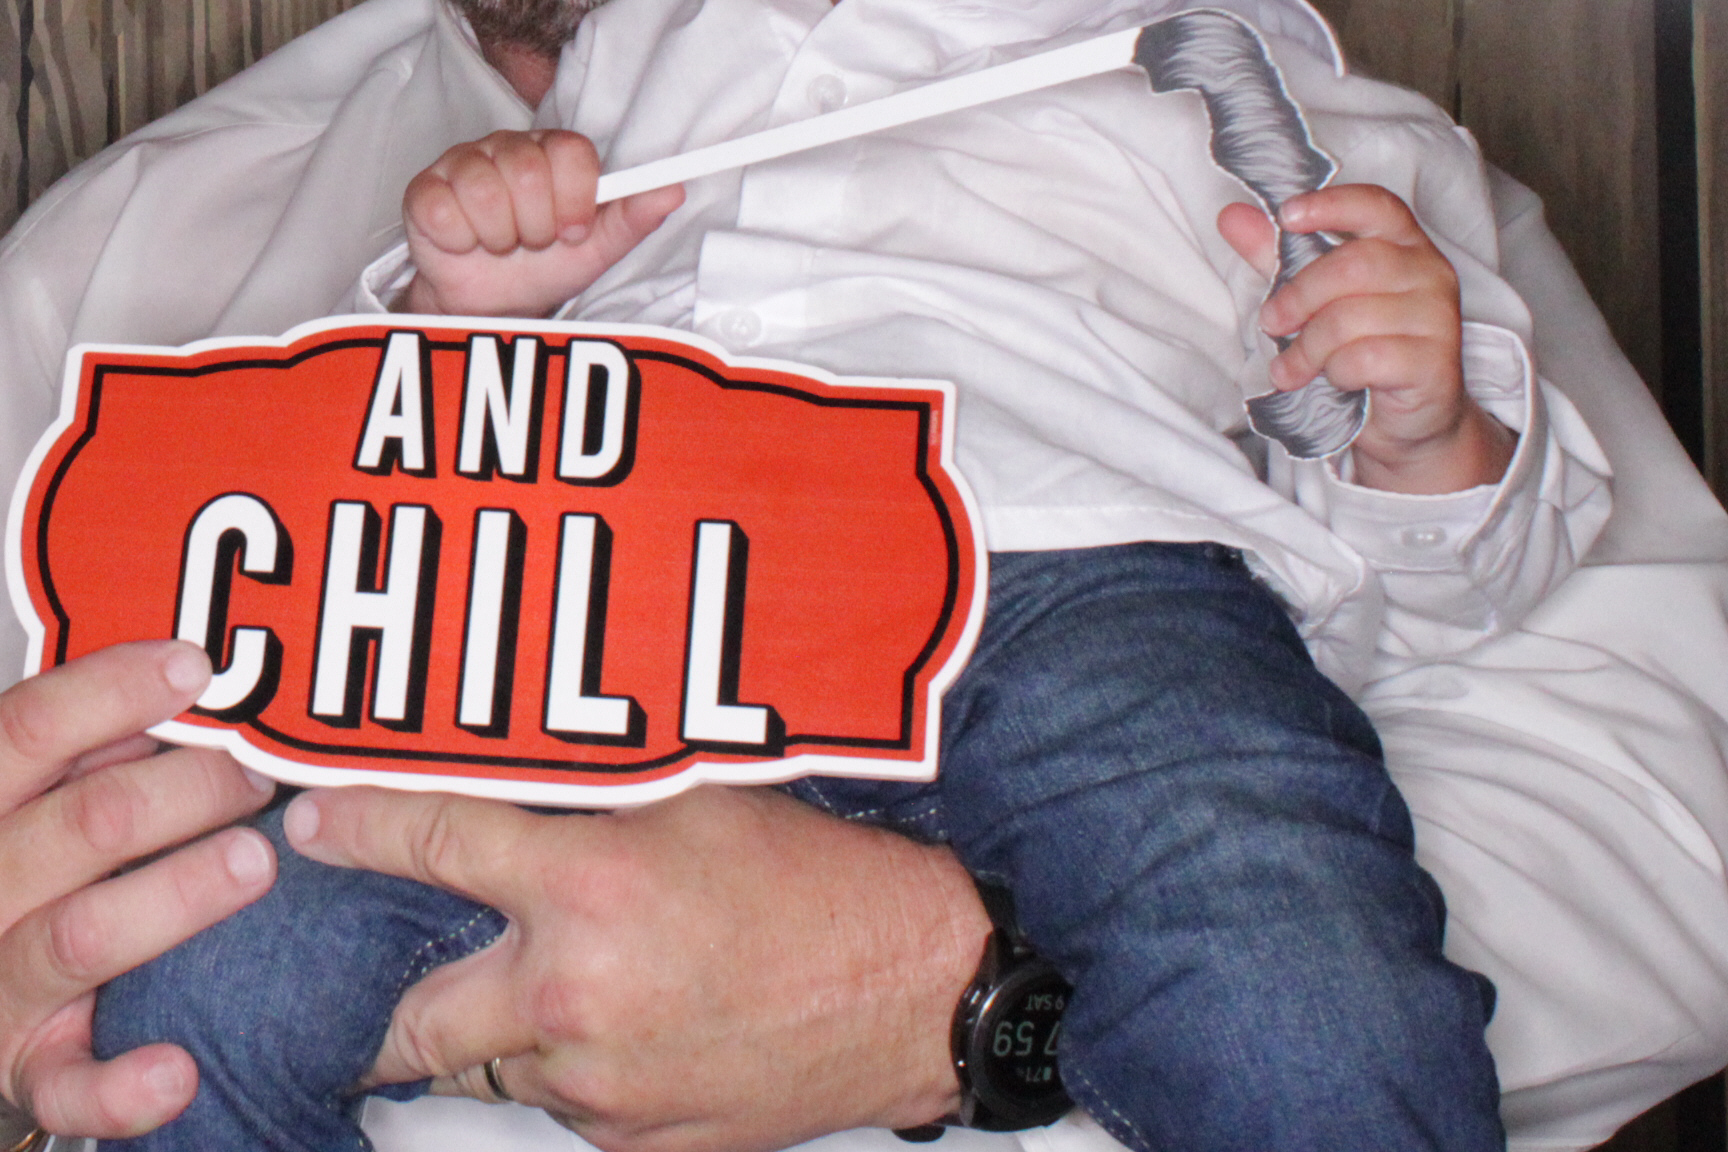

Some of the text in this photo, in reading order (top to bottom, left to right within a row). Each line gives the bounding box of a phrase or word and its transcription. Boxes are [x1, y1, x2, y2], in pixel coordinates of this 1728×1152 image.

[353, 330, 641, 487] AND
[172, 491, 787, 757] CHILL
[992, 1020, 1035, 1057] 59
[1025, 994, 1054, 1011] SAT
